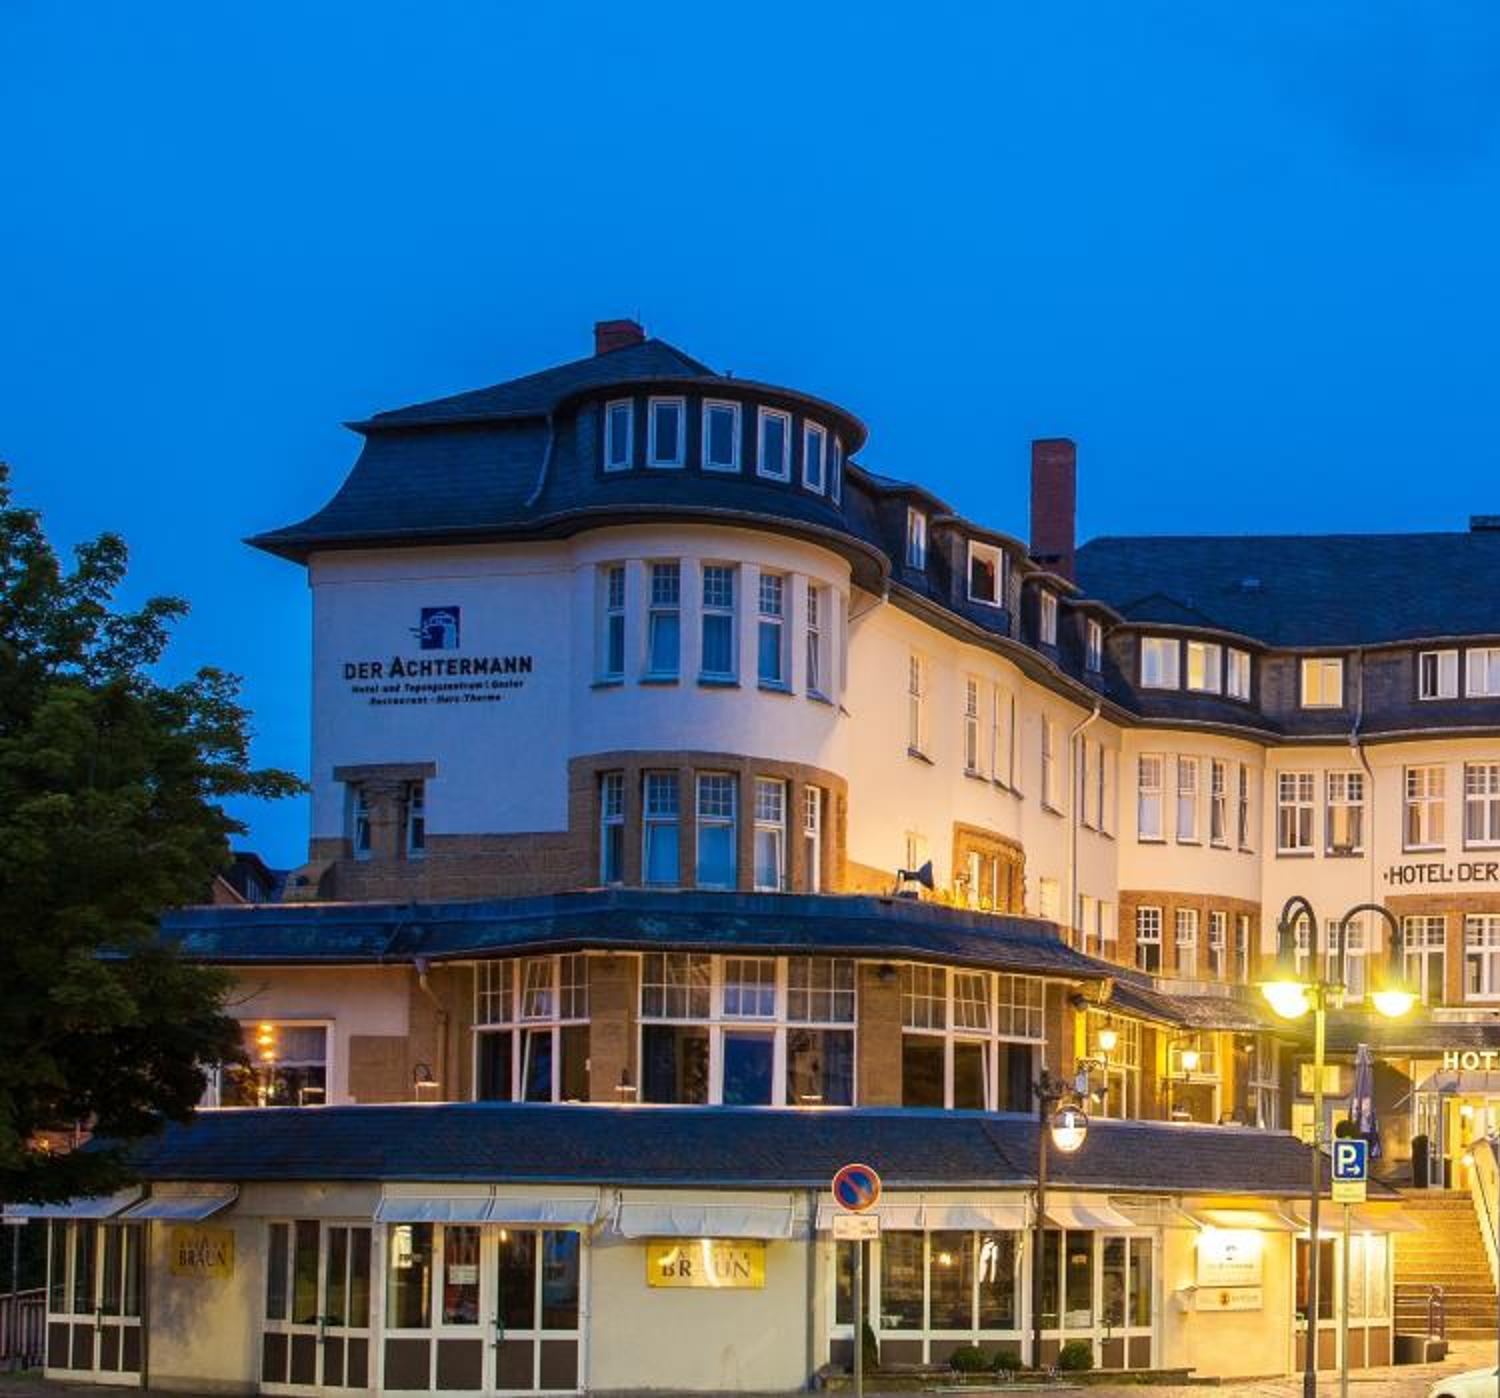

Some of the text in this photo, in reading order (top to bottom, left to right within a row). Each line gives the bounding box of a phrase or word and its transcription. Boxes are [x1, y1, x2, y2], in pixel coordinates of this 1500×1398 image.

[344, 655, 533, 680] DER ACHTERMANN
[383, 683, 400, 693] und
[1457, 862, 1499, 881] DER
[1337, 1144, 1357, 1175] P
[662, 1259, 750, 1278] BRUN
